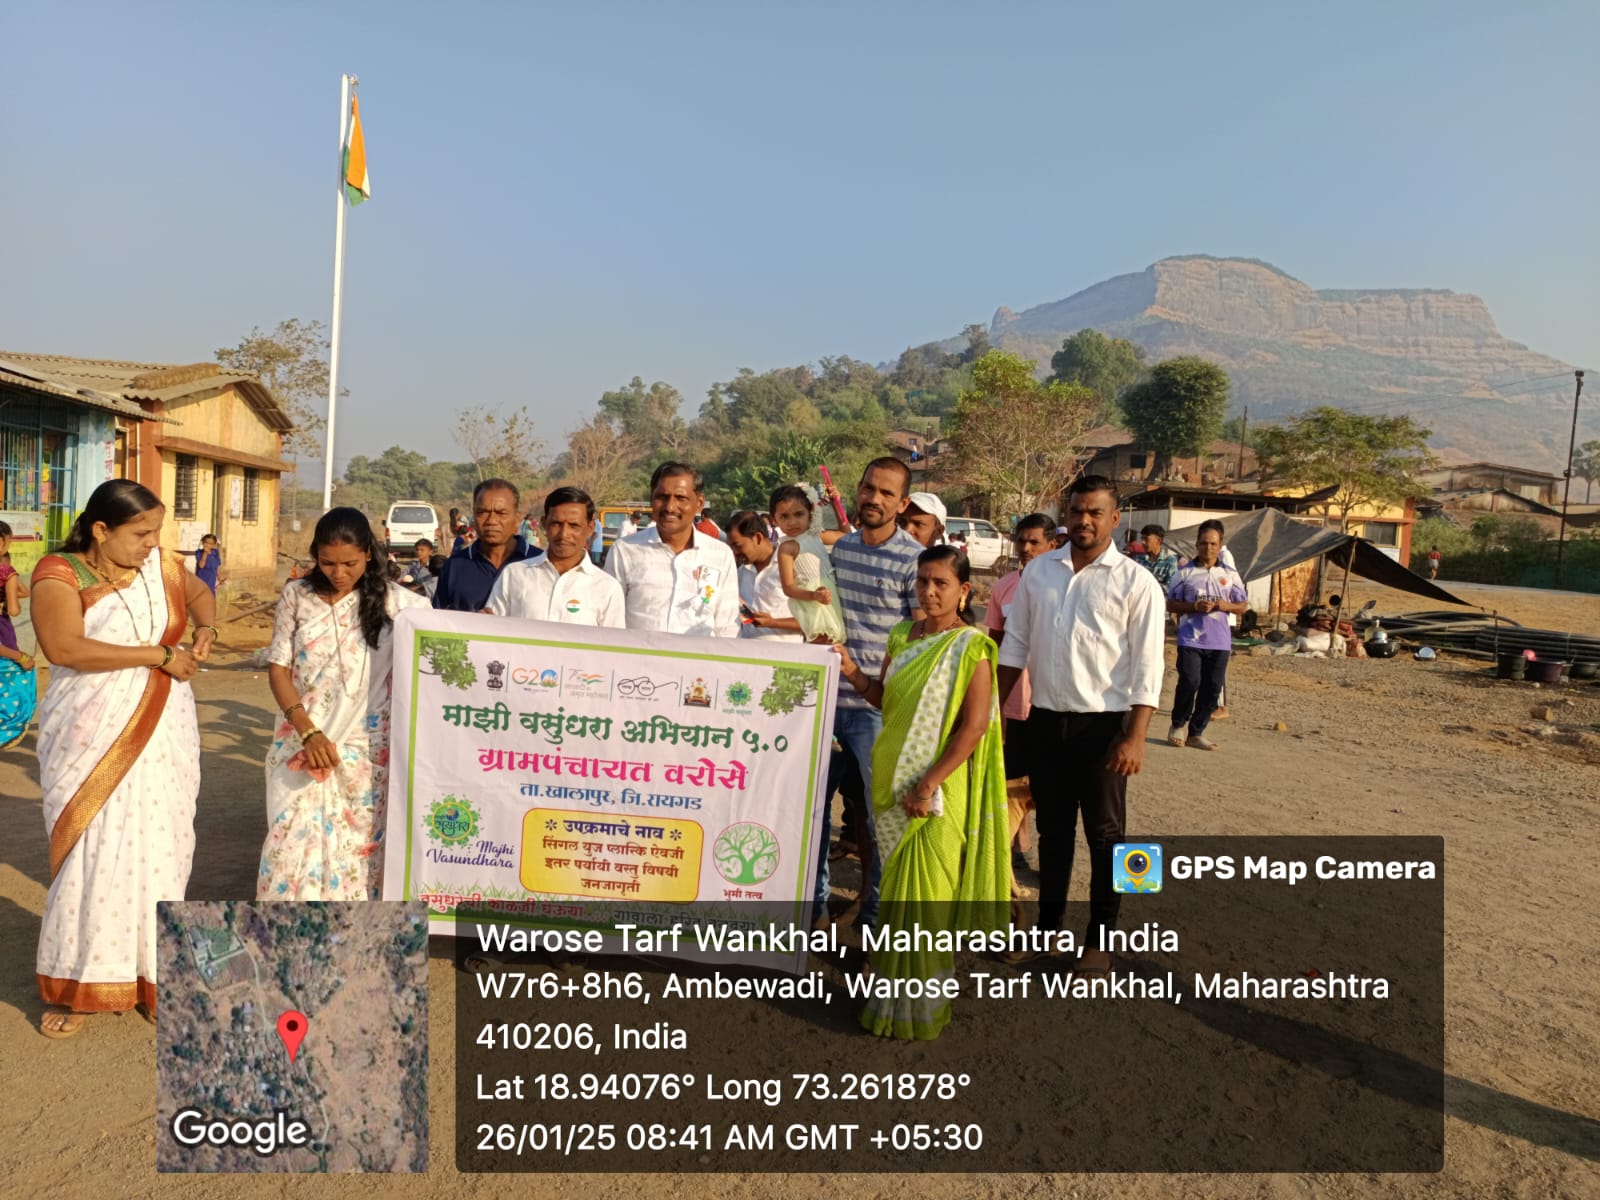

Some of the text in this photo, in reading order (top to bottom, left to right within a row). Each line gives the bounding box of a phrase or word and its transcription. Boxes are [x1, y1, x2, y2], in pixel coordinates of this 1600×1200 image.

[442, 701, 789, 754] माझी वसुंधरा अभियान ५.०
[478, 746, 750, 791] ग्रामपंचायत वरोसे
[563, 819, 664, 840] उपक्रमाचे नाव
[426, 848, 515, 869] Vasundhara
[476, 840, 515, 857] Majhi
[545, 857, 571, 870] इतर
